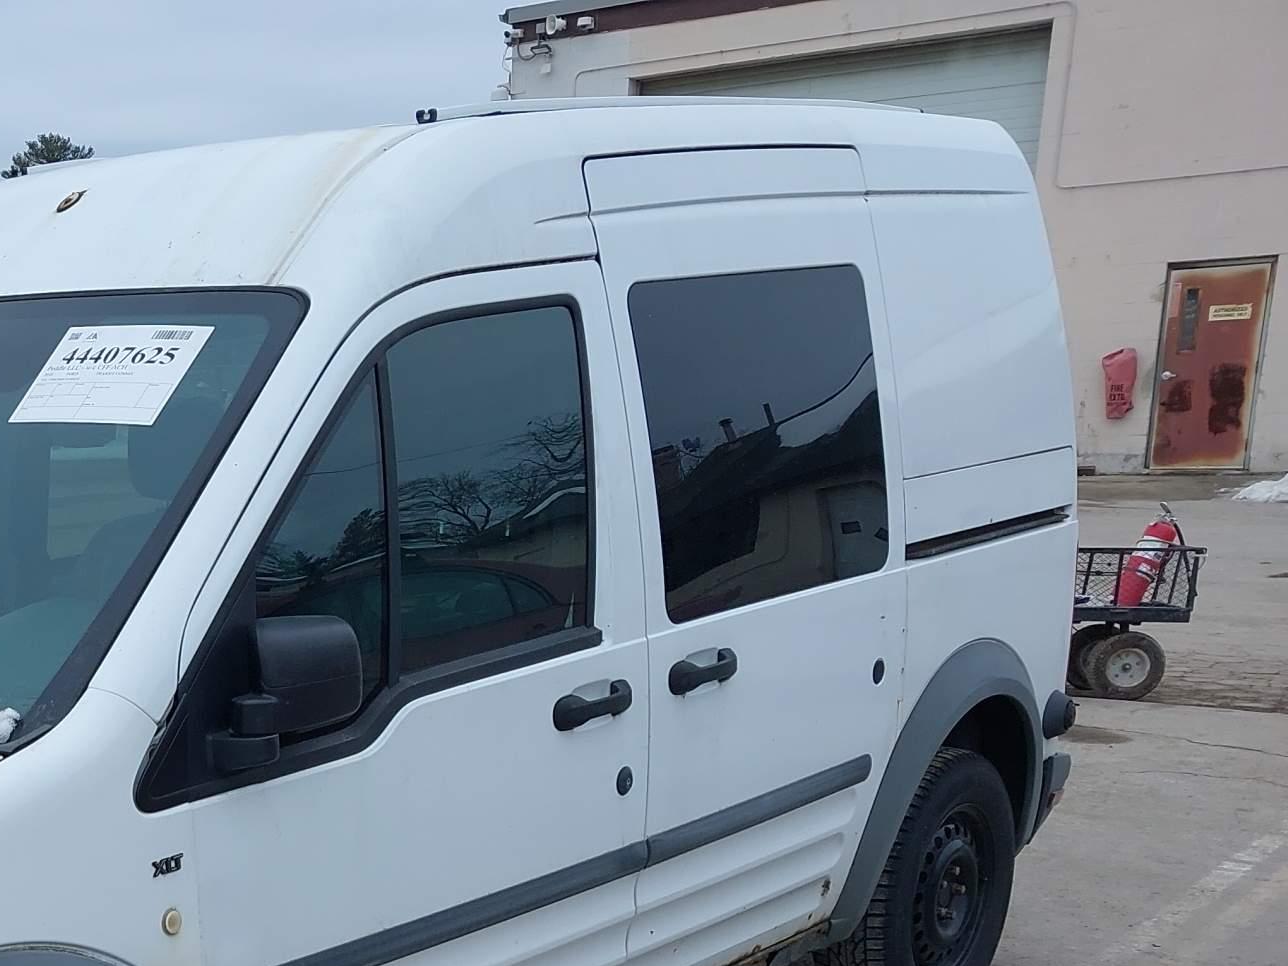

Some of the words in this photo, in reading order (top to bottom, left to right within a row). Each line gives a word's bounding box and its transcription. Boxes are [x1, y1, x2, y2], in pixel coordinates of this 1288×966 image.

[62, 346, 180, 365] 44407625
[1111, 384, 1125, 393] FIRE
[152, 853, 184, 878] XLT
